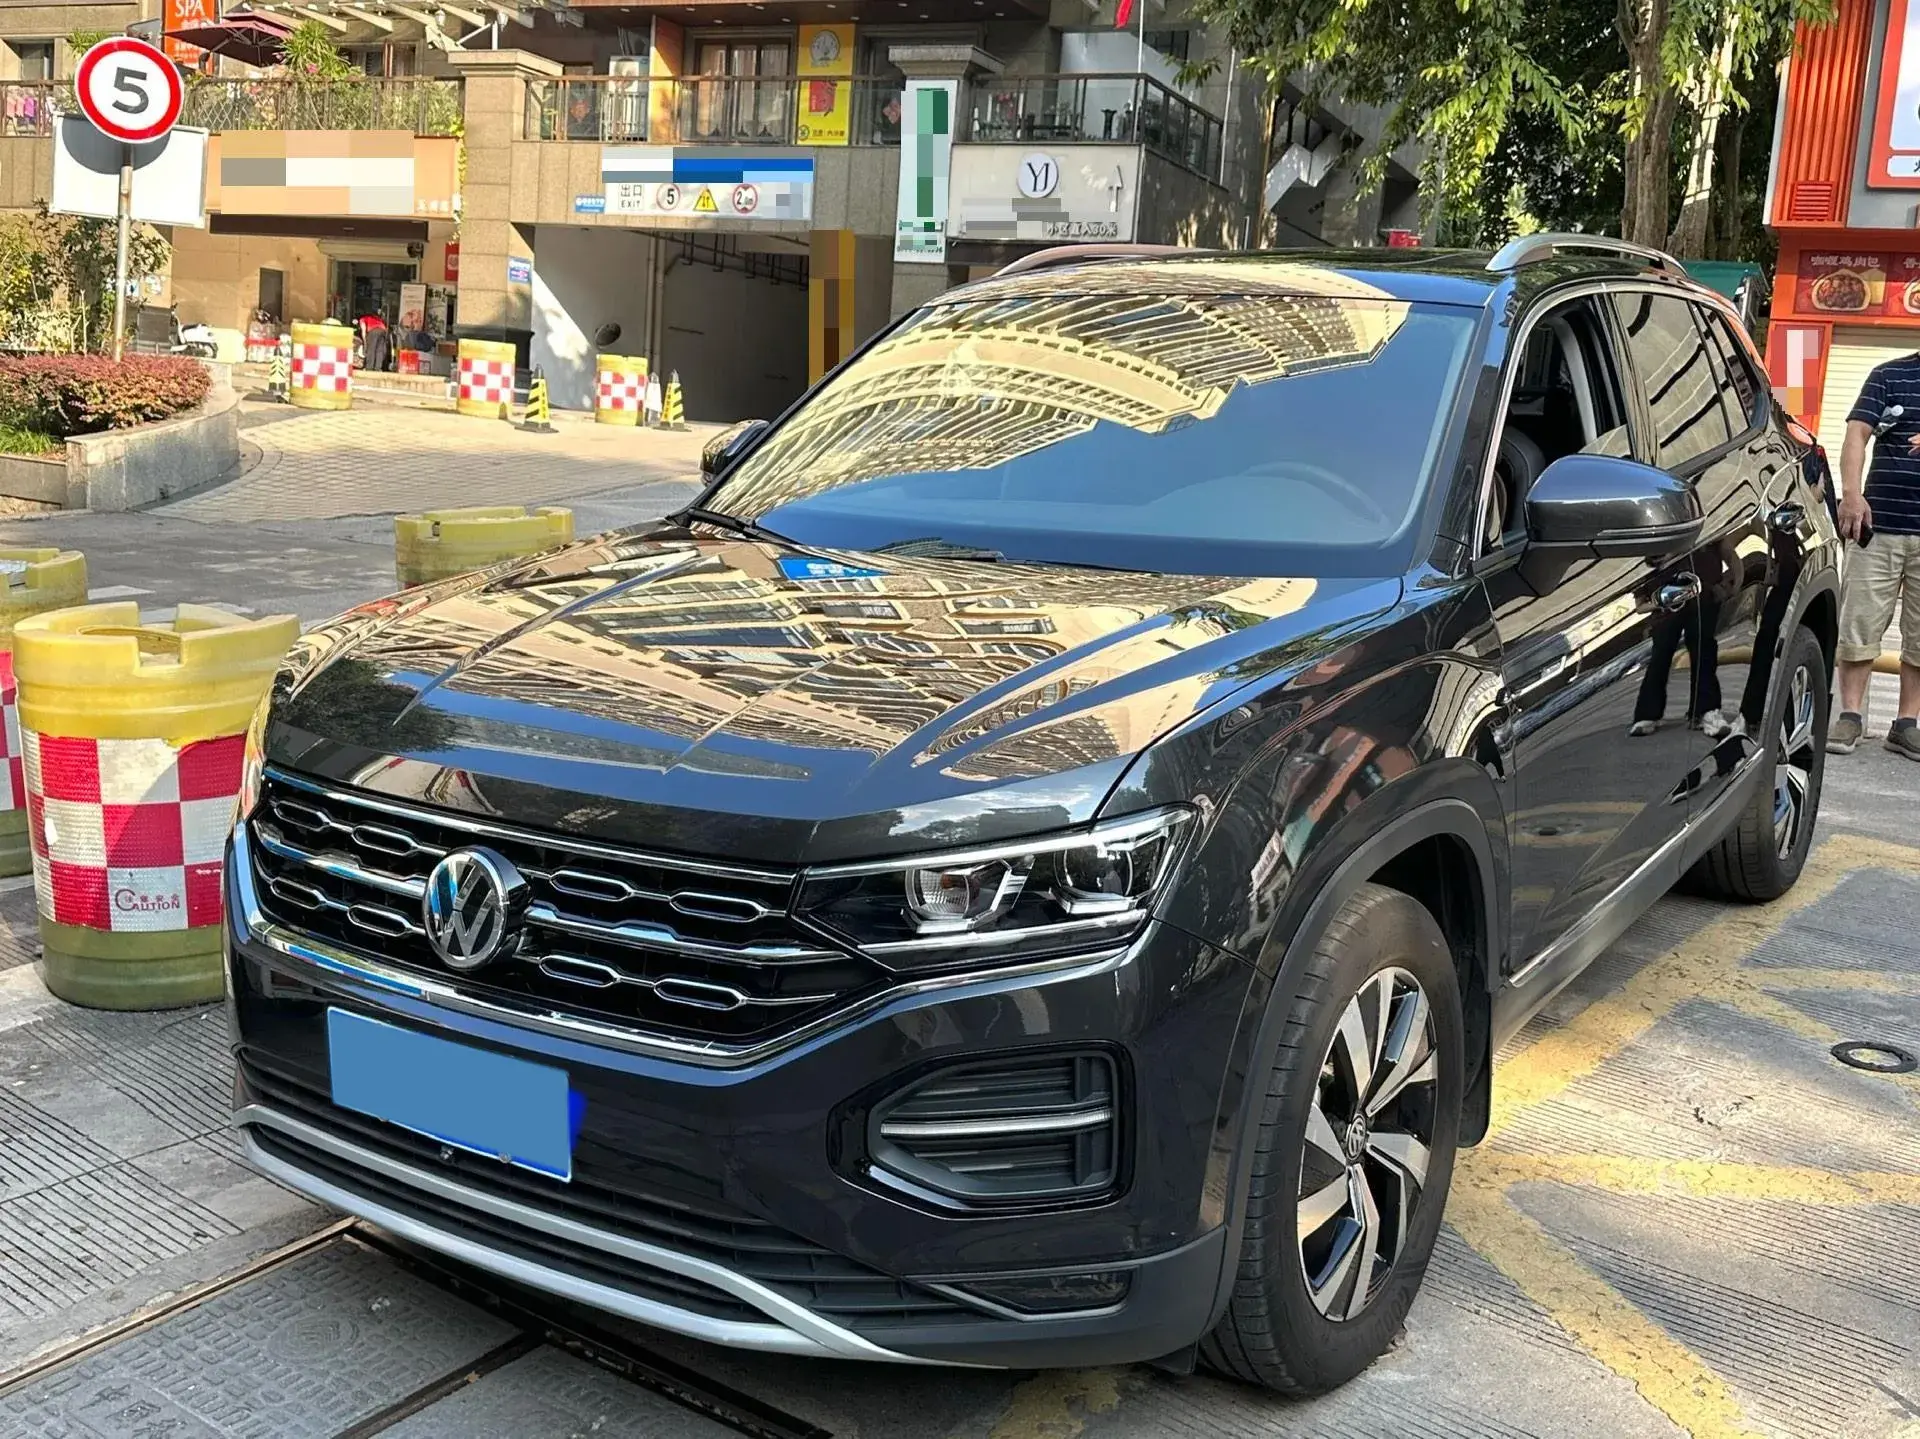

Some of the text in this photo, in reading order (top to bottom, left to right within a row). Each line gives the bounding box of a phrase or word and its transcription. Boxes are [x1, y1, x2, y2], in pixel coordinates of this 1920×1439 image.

[175, 0, 206, 17] SPA
[112, 66, 149, 115] 5
[621, 184, 642, 197] 出口
[667, 188, 675, 205] 5
[621, 200, 641, 208] EXIT
[1811, 255, 1881, 268] 咖喱鸡肉包
